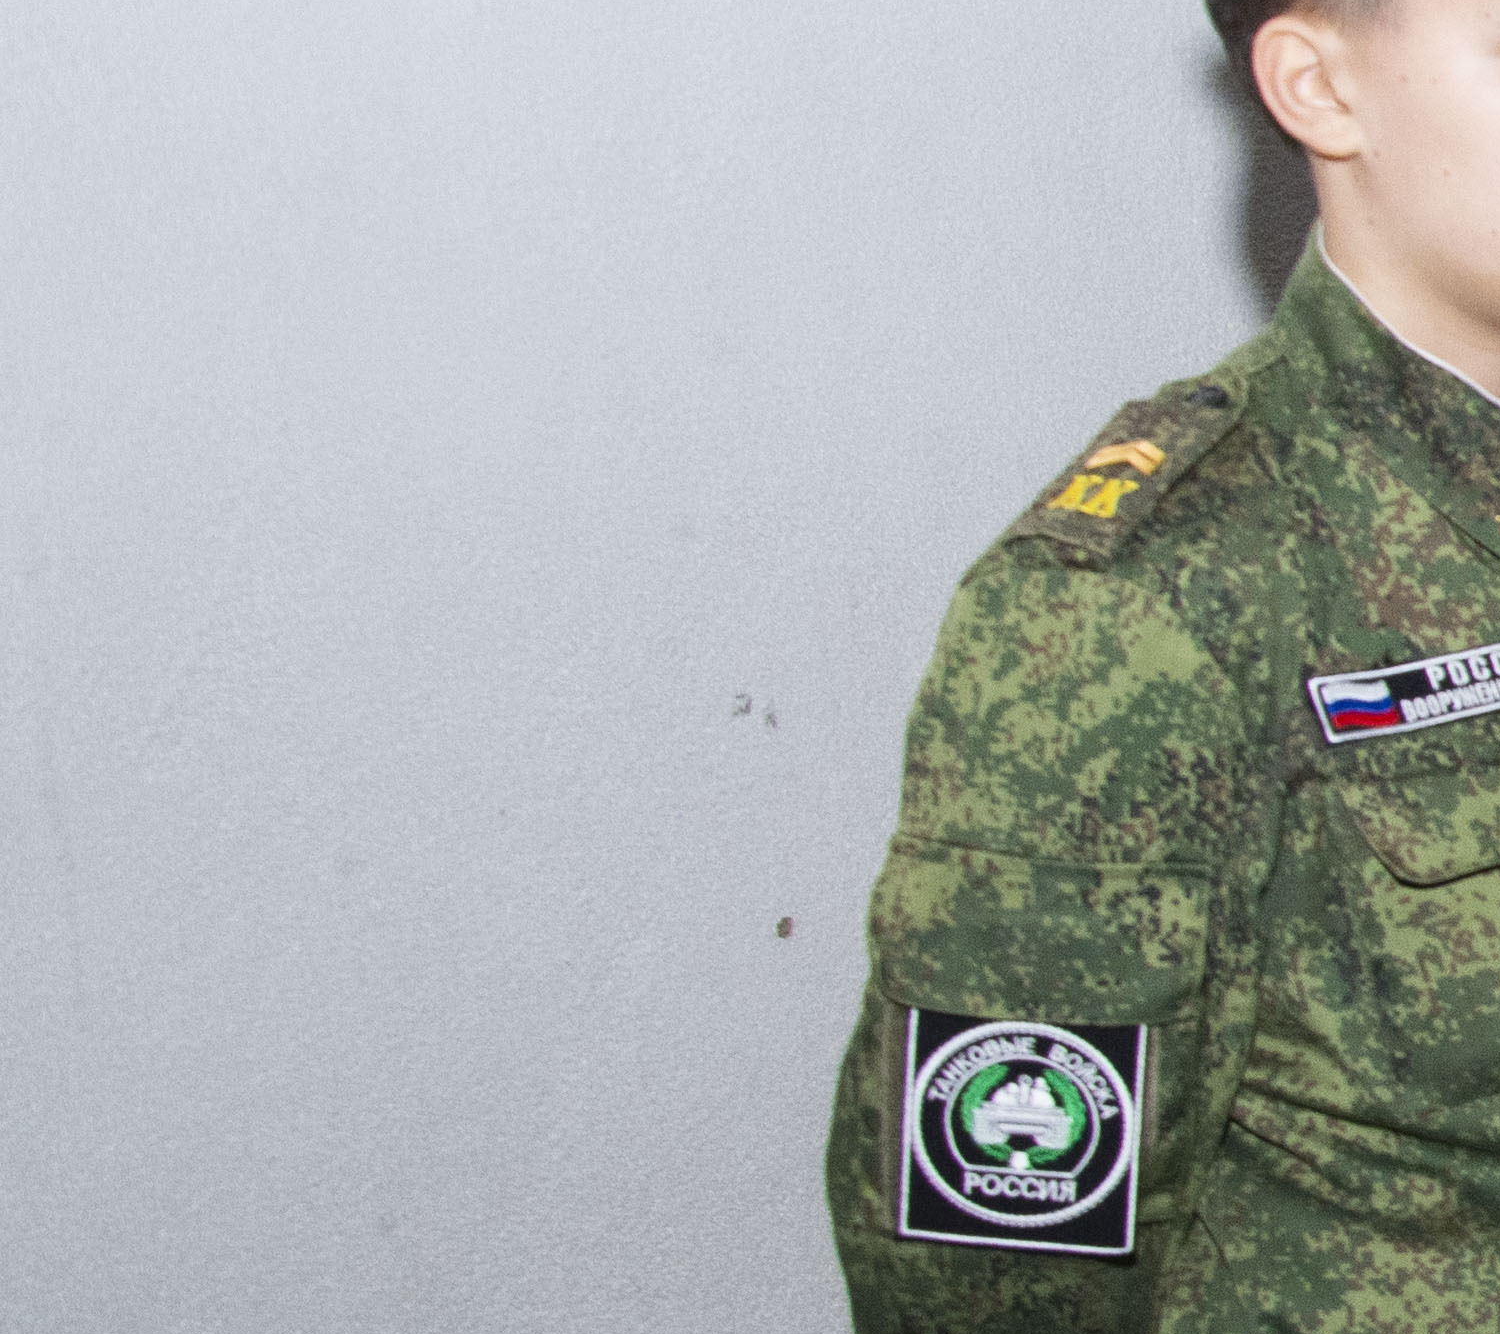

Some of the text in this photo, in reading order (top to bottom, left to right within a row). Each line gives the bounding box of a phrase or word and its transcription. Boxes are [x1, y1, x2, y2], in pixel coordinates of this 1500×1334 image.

[927, 1036, 1120, 1121] ТАНКОВЫЕ ВОЙСКА
[963, 1172, 1078, 1202] РОССИЯ
